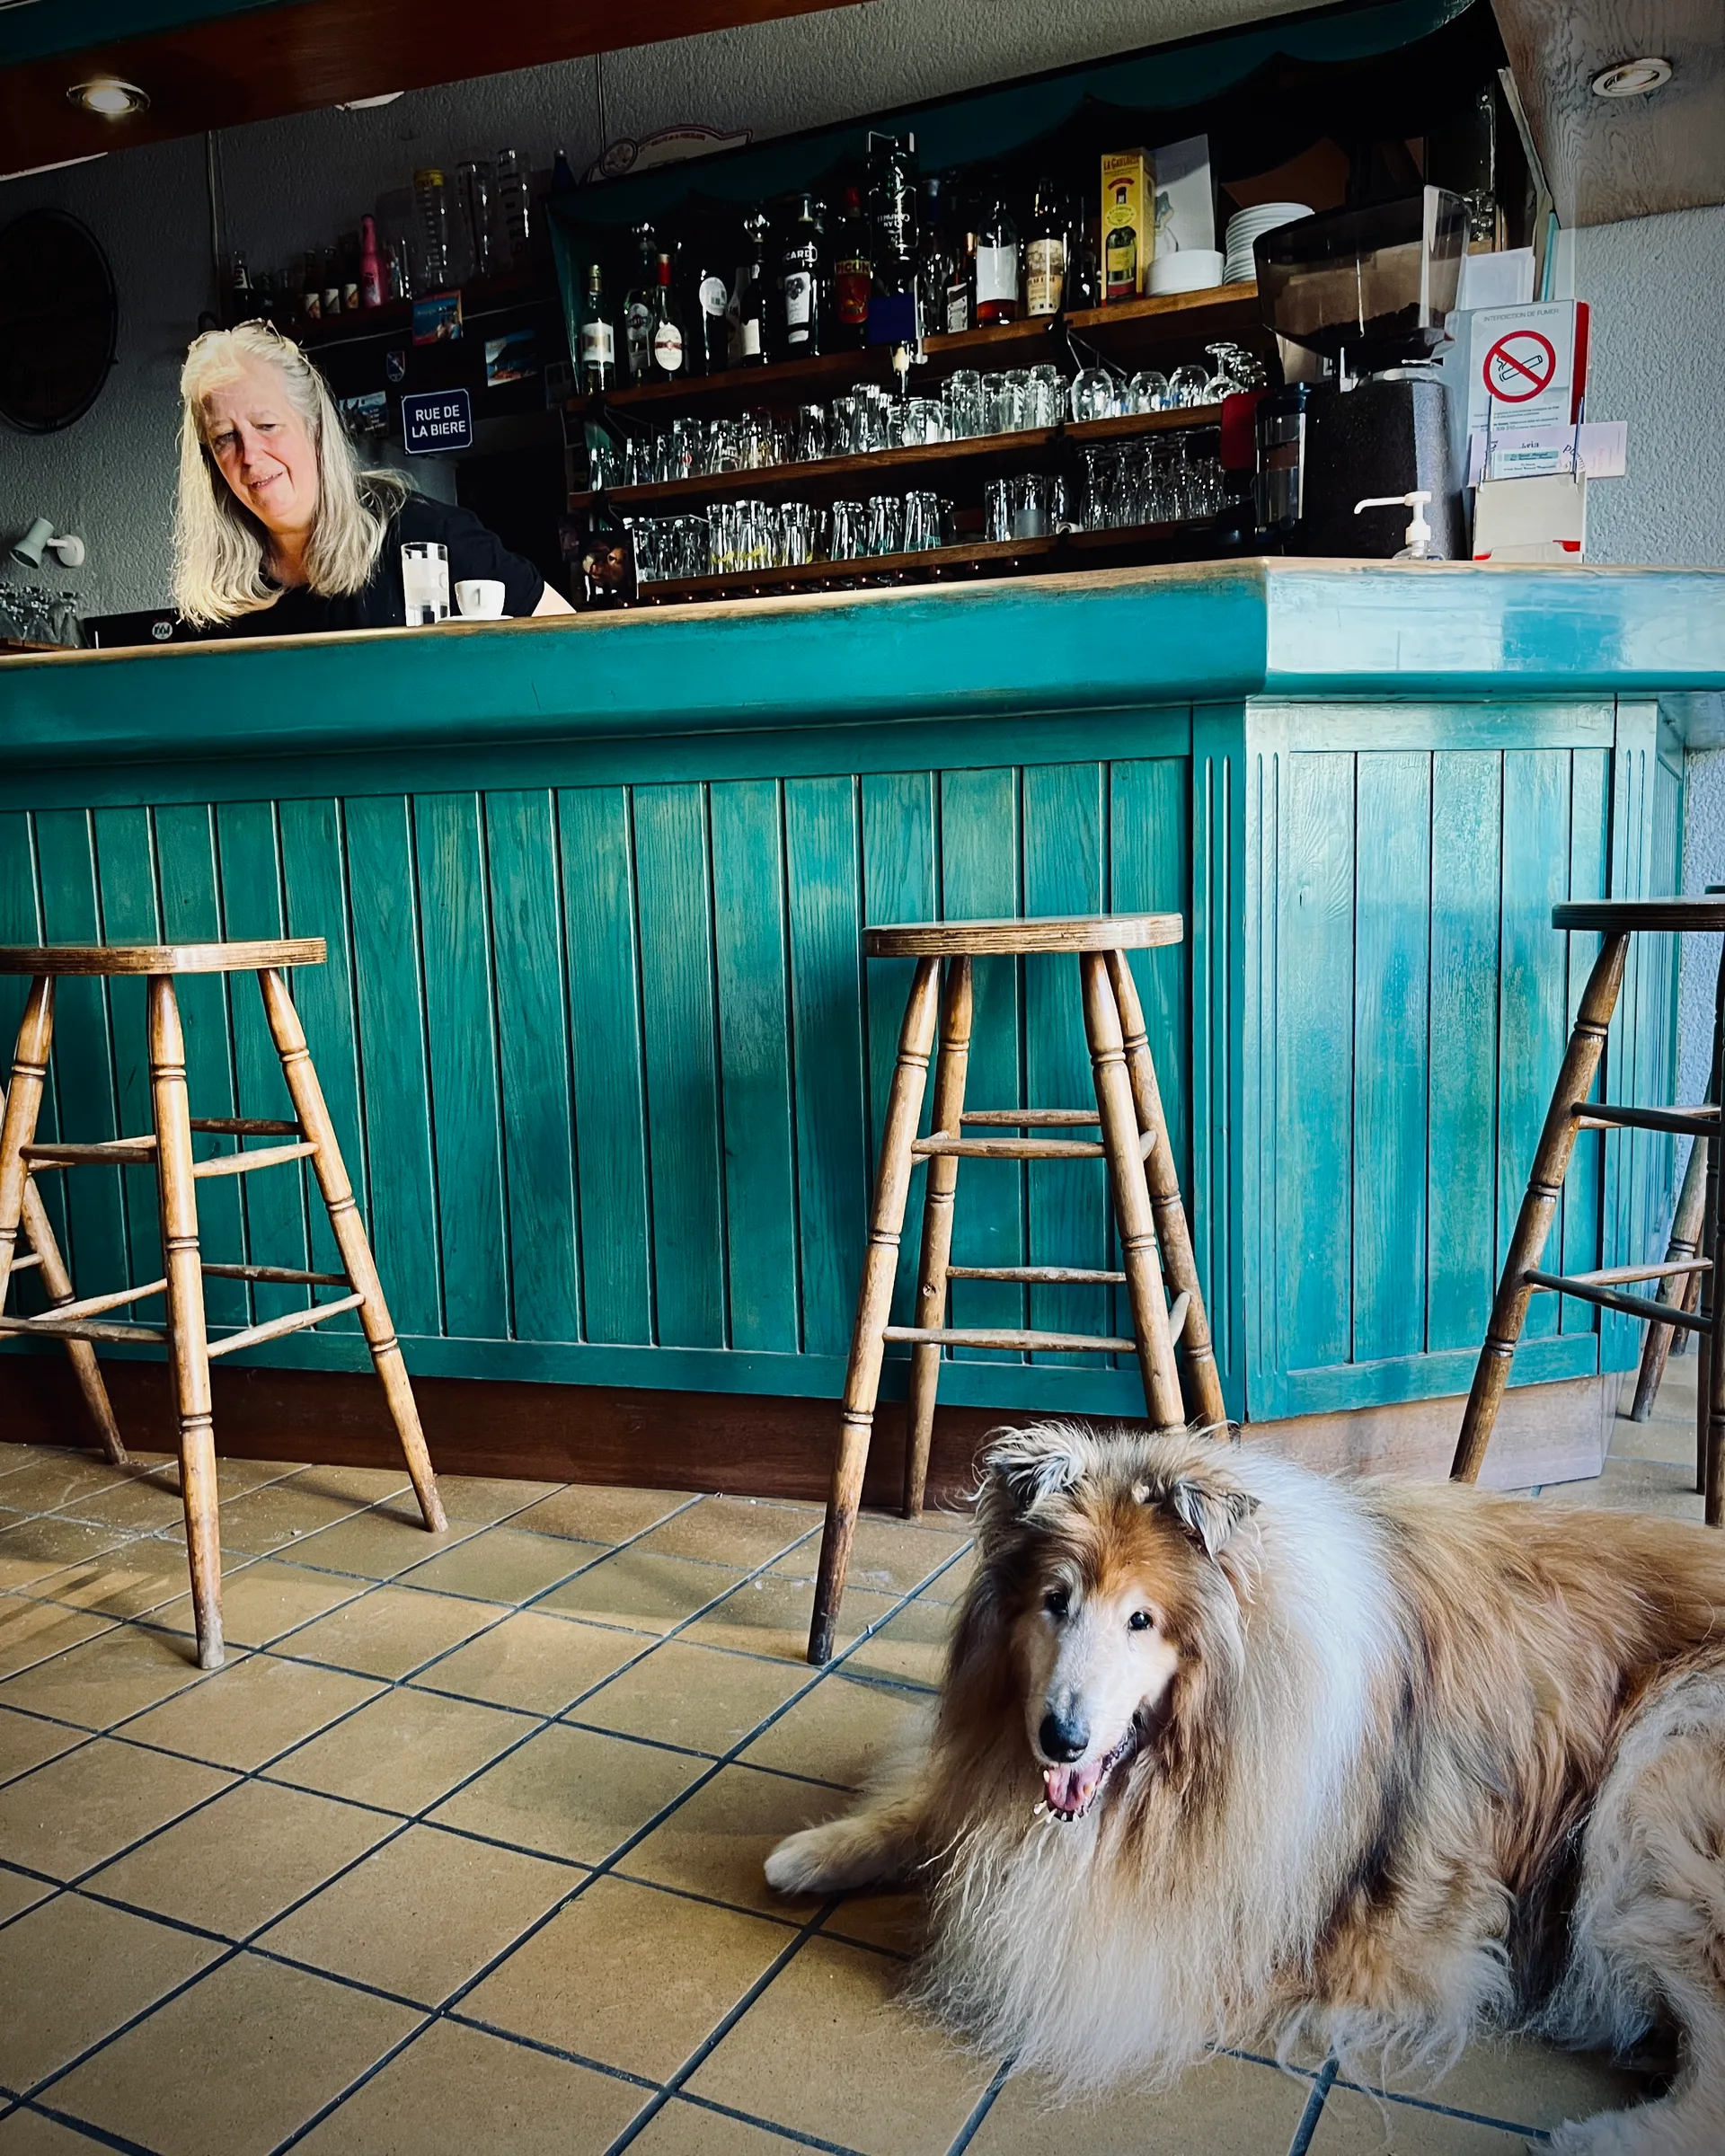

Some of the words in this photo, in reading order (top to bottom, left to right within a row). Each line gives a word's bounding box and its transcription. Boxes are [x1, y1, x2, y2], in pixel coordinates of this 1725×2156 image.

[1483, 312, 1526, 323] INTERDICTION
[1536, 307, 1560, 316] FUMER
[415, 407, 441, 422] RUE
[443, 404, 460, 419] DE
[411, 425, 429, 438] LA
[430, 420, 466, 437] BIERE
